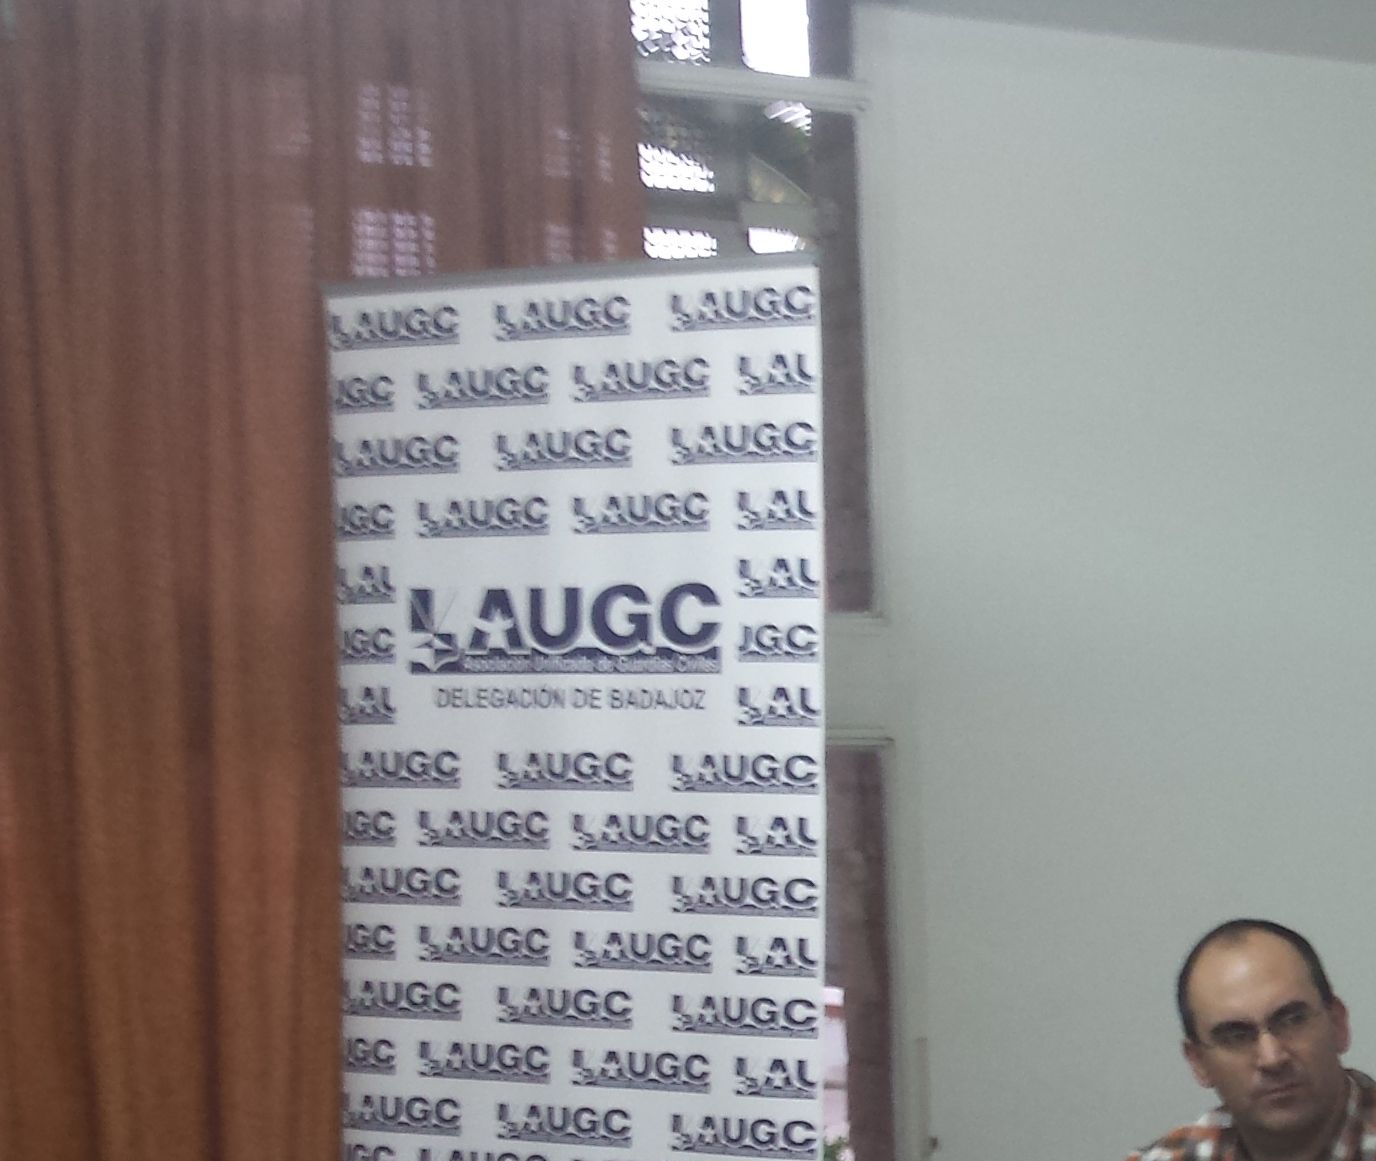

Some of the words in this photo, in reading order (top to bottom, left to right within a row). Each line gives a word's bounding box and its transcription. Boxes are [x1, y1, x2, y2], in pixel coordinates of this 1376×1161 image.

[435, 683, 564, 710] DELEGACIÓN
[572, 688, 603, 710] DE
[609, 687, 707, 711] BADAJOZ
